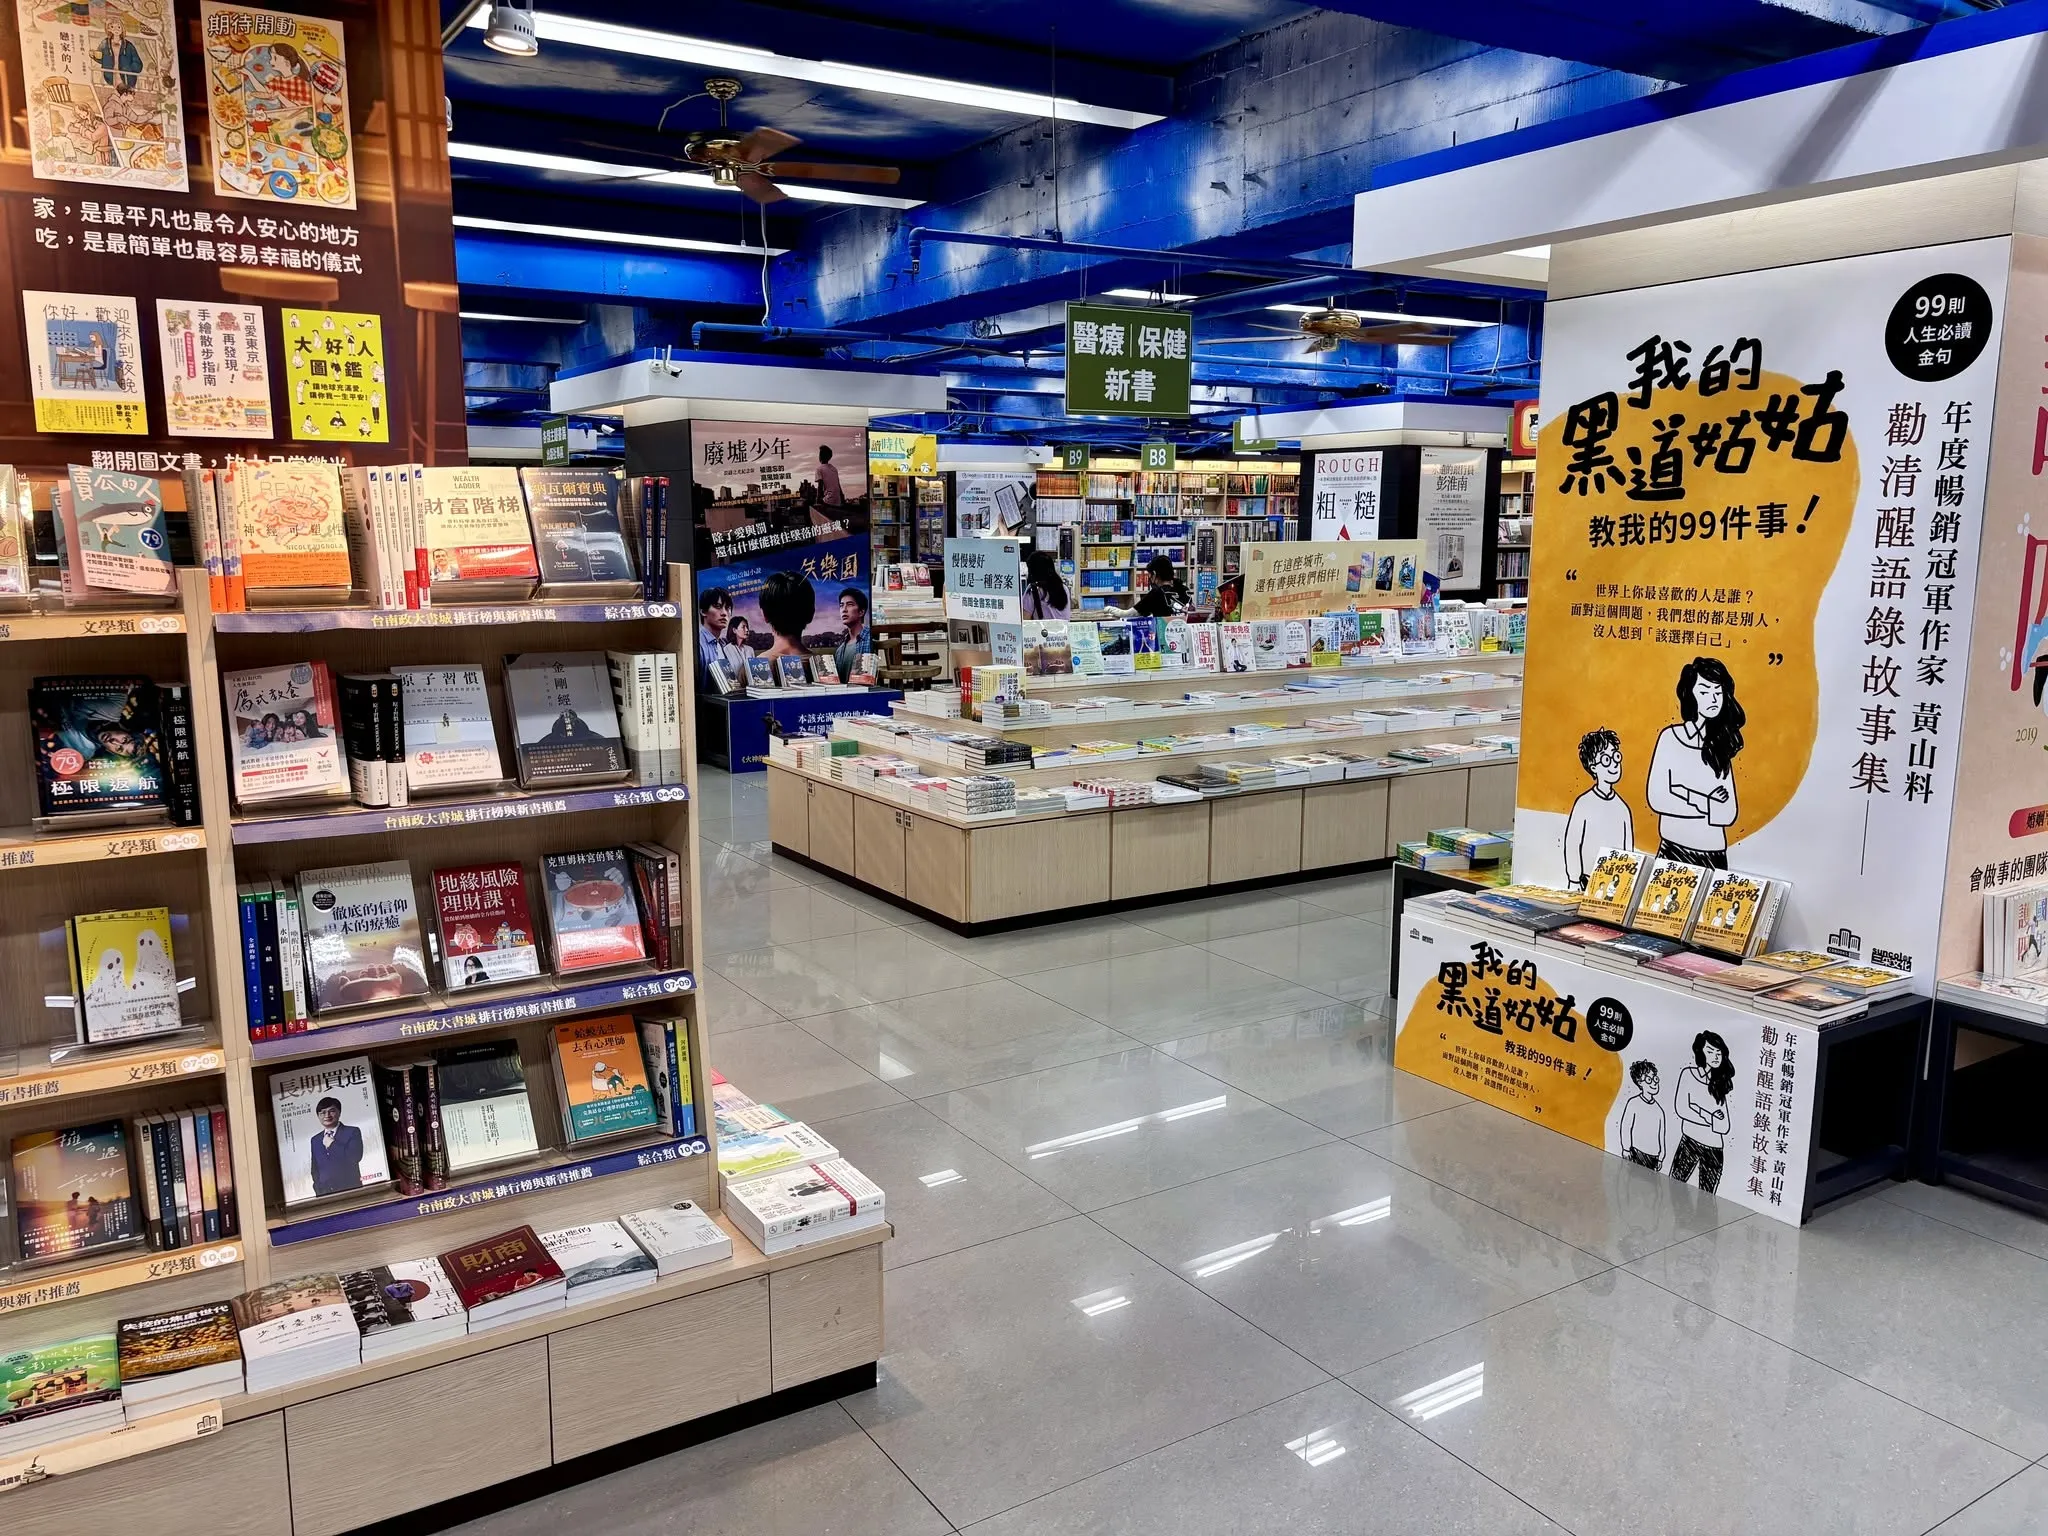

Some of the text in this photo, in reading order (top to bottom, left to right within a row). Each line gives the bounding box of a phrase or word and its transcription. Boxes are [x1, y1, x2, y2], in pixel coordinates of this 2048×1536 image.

[208, 14, 297, 38] 期待開動
[60, 31, 73, 75] 戀家的人
[33, 197, 359, 248] 家，是最平凡也最令人安心的地方
[36, 228, 363, 275] 吃，是最簡單也最容易幸福的儀式
[1915, 294, 1965, 319] 99則
[243, 311, 260, 363] 可愛東京
[1072, 320, 1187, 360] 醫療 保健
[1904, 321, 1973, 345] 人生必讀
[198, 308, 217, 388] 手繪散步指南
[1918, 347, 1952, 367] 金句
[310, 359, 363, 379] 圖鑑
[1626, 334, 1764, 411] 我的
[1104, 367, 1156, 403] 新書
[1559, 369, 1850, 503] 黑道姑姑
[704, 437, 791, 466] 廢墟少年
[1069, 450, 1082, 465] B9
[1150, 449, 1166, 466] B8
[1317, 457, 1379, 474] ROUGH
[453, 475, 480, 483] WEALTH
[424, 496, 520, 516] 財富階梯
[1315, 490, 1377, 521] 粗糙
[1588, 493, 1821, 549] 教我的99件事！
[958, 572, 1014, 590] 也是一種答案
[1595, 583, 1755, 605] 世界上你最喜歡的人是誰？
[1849, 402, 1928, 795] 勸清醒語錄故事集
[1903, 400, 1973, 804] 年度暢銷冠軍作家 黃山料
[605, 606, 677, 620] 綜合類 01-03
[1570, 602, 1782, 630] 面對這個問題，我們想的都是別人，
[81, 619, 136, 635] 文學類
[1592, 623, 1750, 649] 沒人想到「該選擇自己」。
[401, 671, 479, 688] 原子習慣
[552, 660, 572, 706] 金剛經
[173, 715, 189, 761] 極限返航
[2015, 726, 2038, 743] 2019
[51, 775, 159, 797] 極限返航
[613, 788, 685, 807] 綜合類 04-06
[1, 850, 35, 867] 推薦
[104, 837, 157, 857] 文學類
[439, 868, 519, 893] 地緣風險
[331, 898, 408, 921] 徹底的信仰
[442, 889, 503, 913] 理財課
[1470, 941, 1537, 990] 我的
[1872, 947, 1912, 961] suncolor
[623, 979, 691, 1000] 綜合類 07-09
[1435, 961, 1578, 1044] 黑道姑姑
[1599, 1004, 1623, 1022] 99則
[574, 1023, 617, 1039] 蛤蟆先生
[572, 1036, 626, 1053] 去看心理師
[128, 1060, 178, 1082] 文學類
[279, 1064, 368, 1102] 長期買進
[1747, 1025, 1778, 1197] 勸清醒語錄故事集
[1769, 1032, 1798, 1207] 年度暢銷冠軍作家 黃山料
[486, 1104, 500, 1146] 我可能錯了
[637, 1147, 677, 1166] 綜合類
[147, 1255, 196, 1278] 文學類
[459, 1238, 528, 1272] 財商
